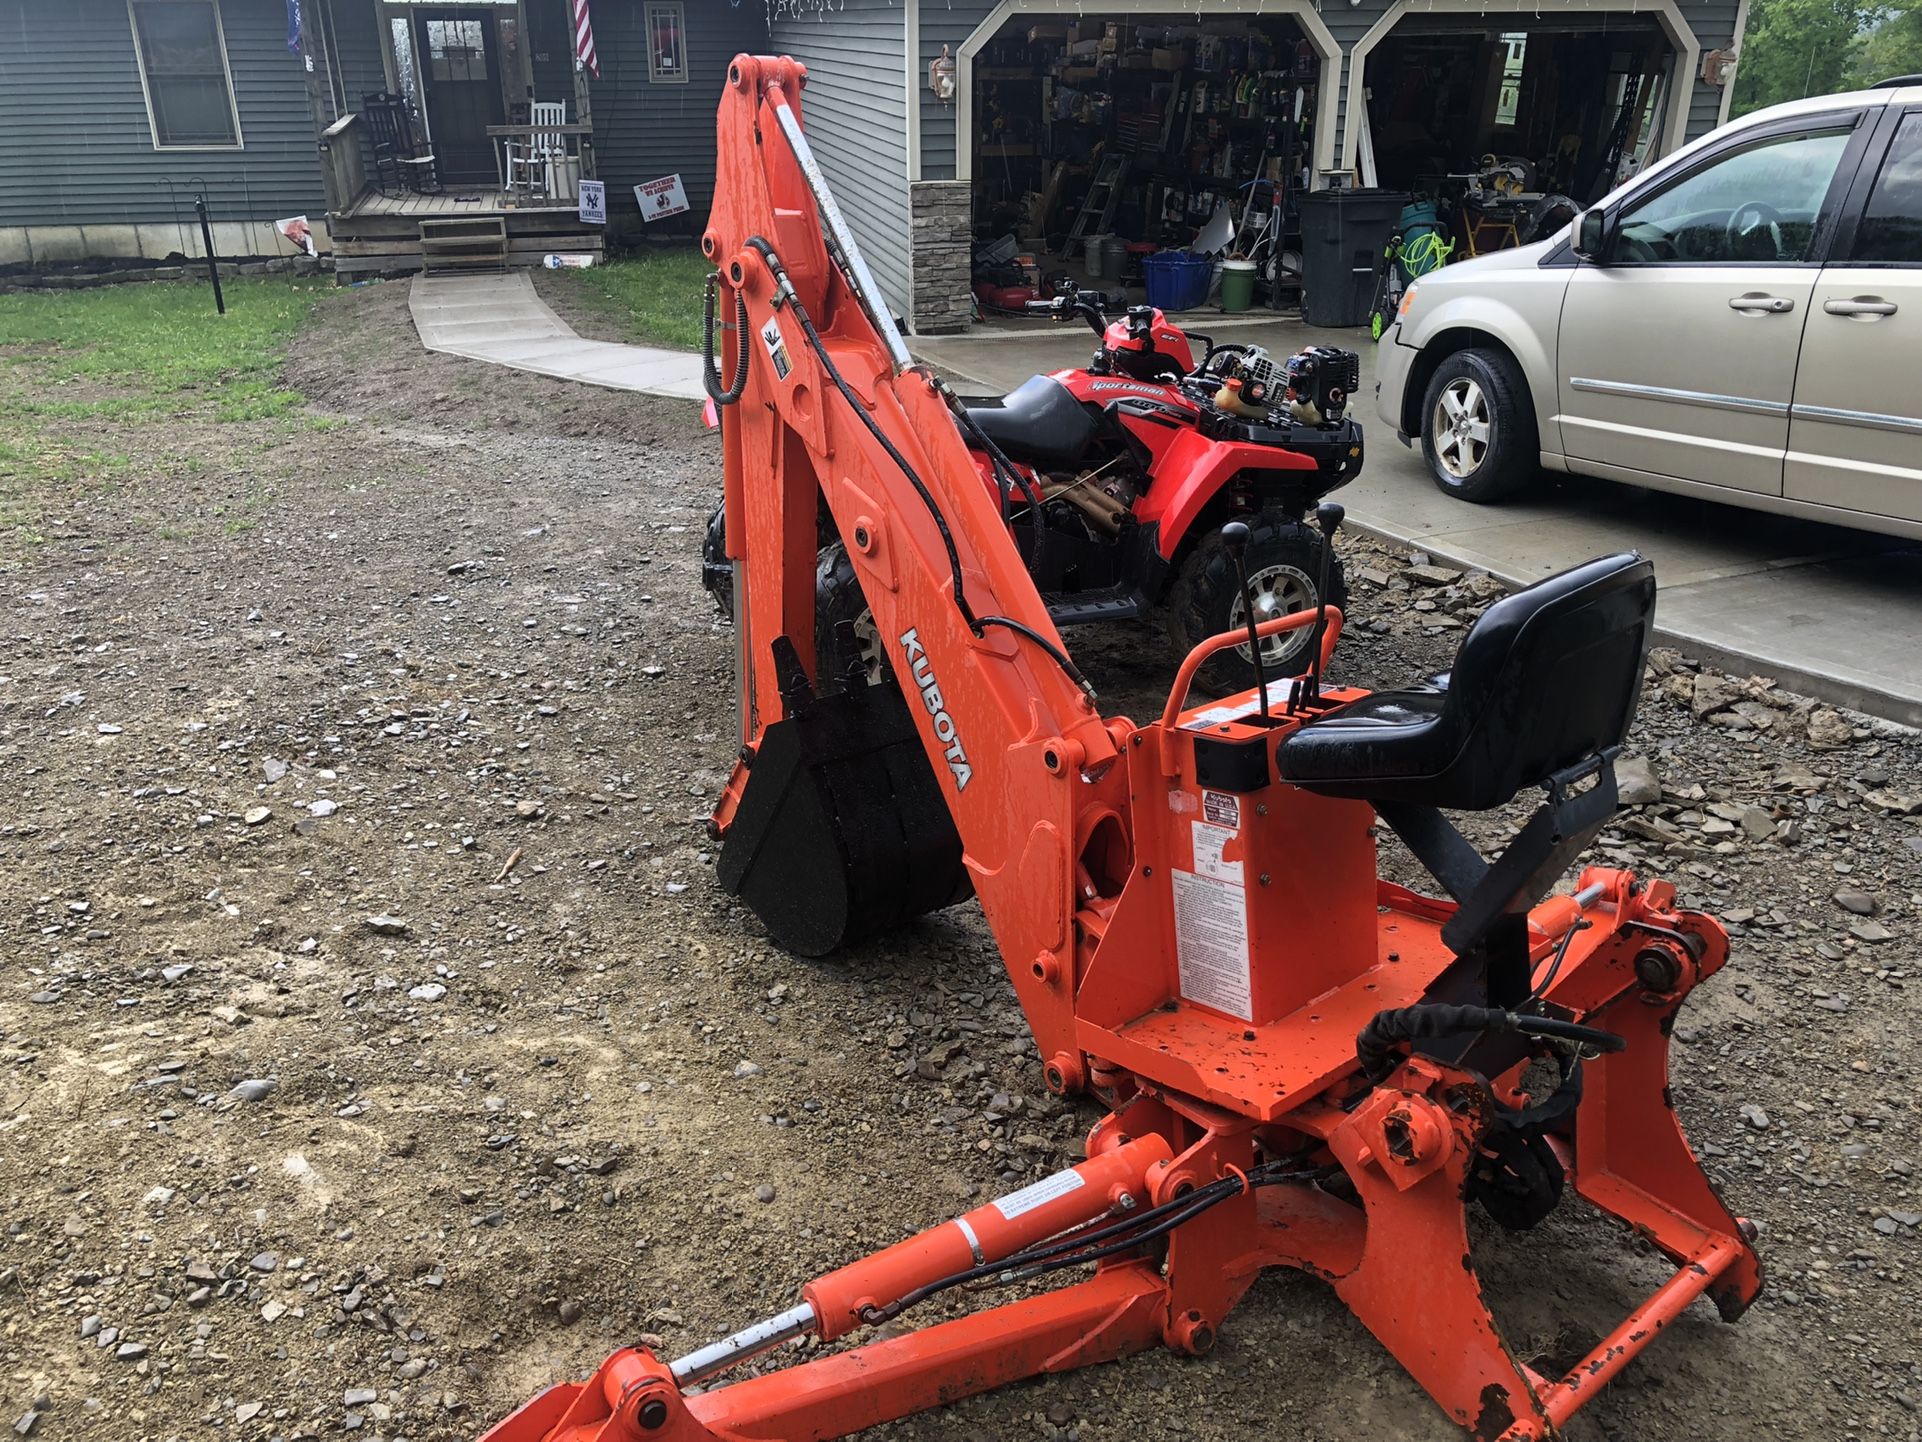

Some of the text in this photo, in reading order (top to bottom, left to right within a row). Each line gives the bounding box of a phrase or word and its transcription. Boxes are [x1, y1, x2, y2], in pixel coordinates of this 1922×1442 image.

[639, 177, 676, 192] TOGETHER
[581, 210, 603, 218] YANKEES
[899, 626, 973, 792] KUBOTA
